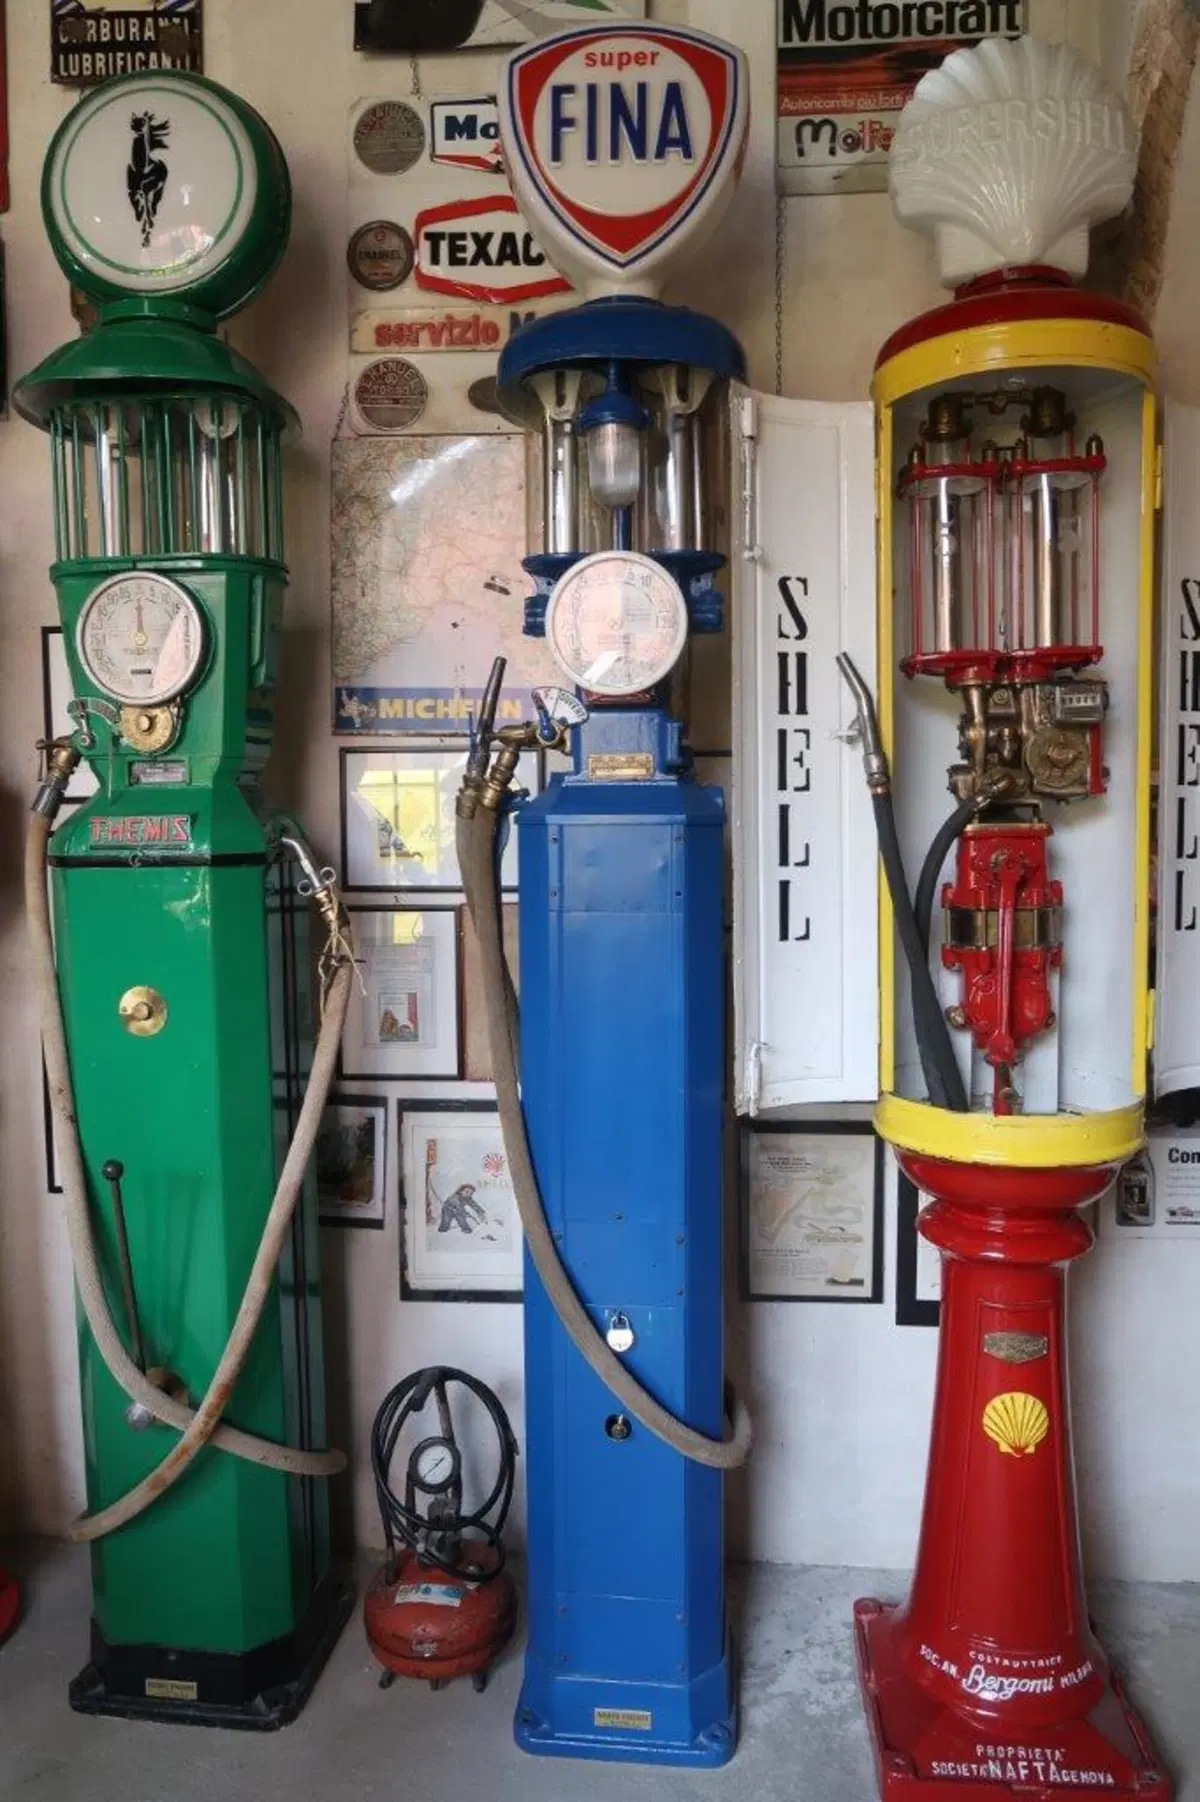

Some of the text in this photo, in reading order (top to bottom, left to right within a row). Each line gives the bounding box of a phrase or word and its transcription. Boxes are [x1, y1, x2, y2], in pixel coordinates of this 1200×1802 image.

[783, 0, 1021, 42] Motorcraft
[585, 51, 660, 71] super
[445, 115, 500, 141] Mo
[551, 82, 693, 165] FINA
[424, 231, 546, 267] TEXAC
[375, 314, 500, 347] servizio
[379, 698, 521, 719] MICHEN
[777, 576, 809, 941] SHELL
[92, 816, 188, 843] THEMIS
[962, 1664, 1054, 1699] Bergomi
[988, 1760, 1061, 1782] NAFTA
